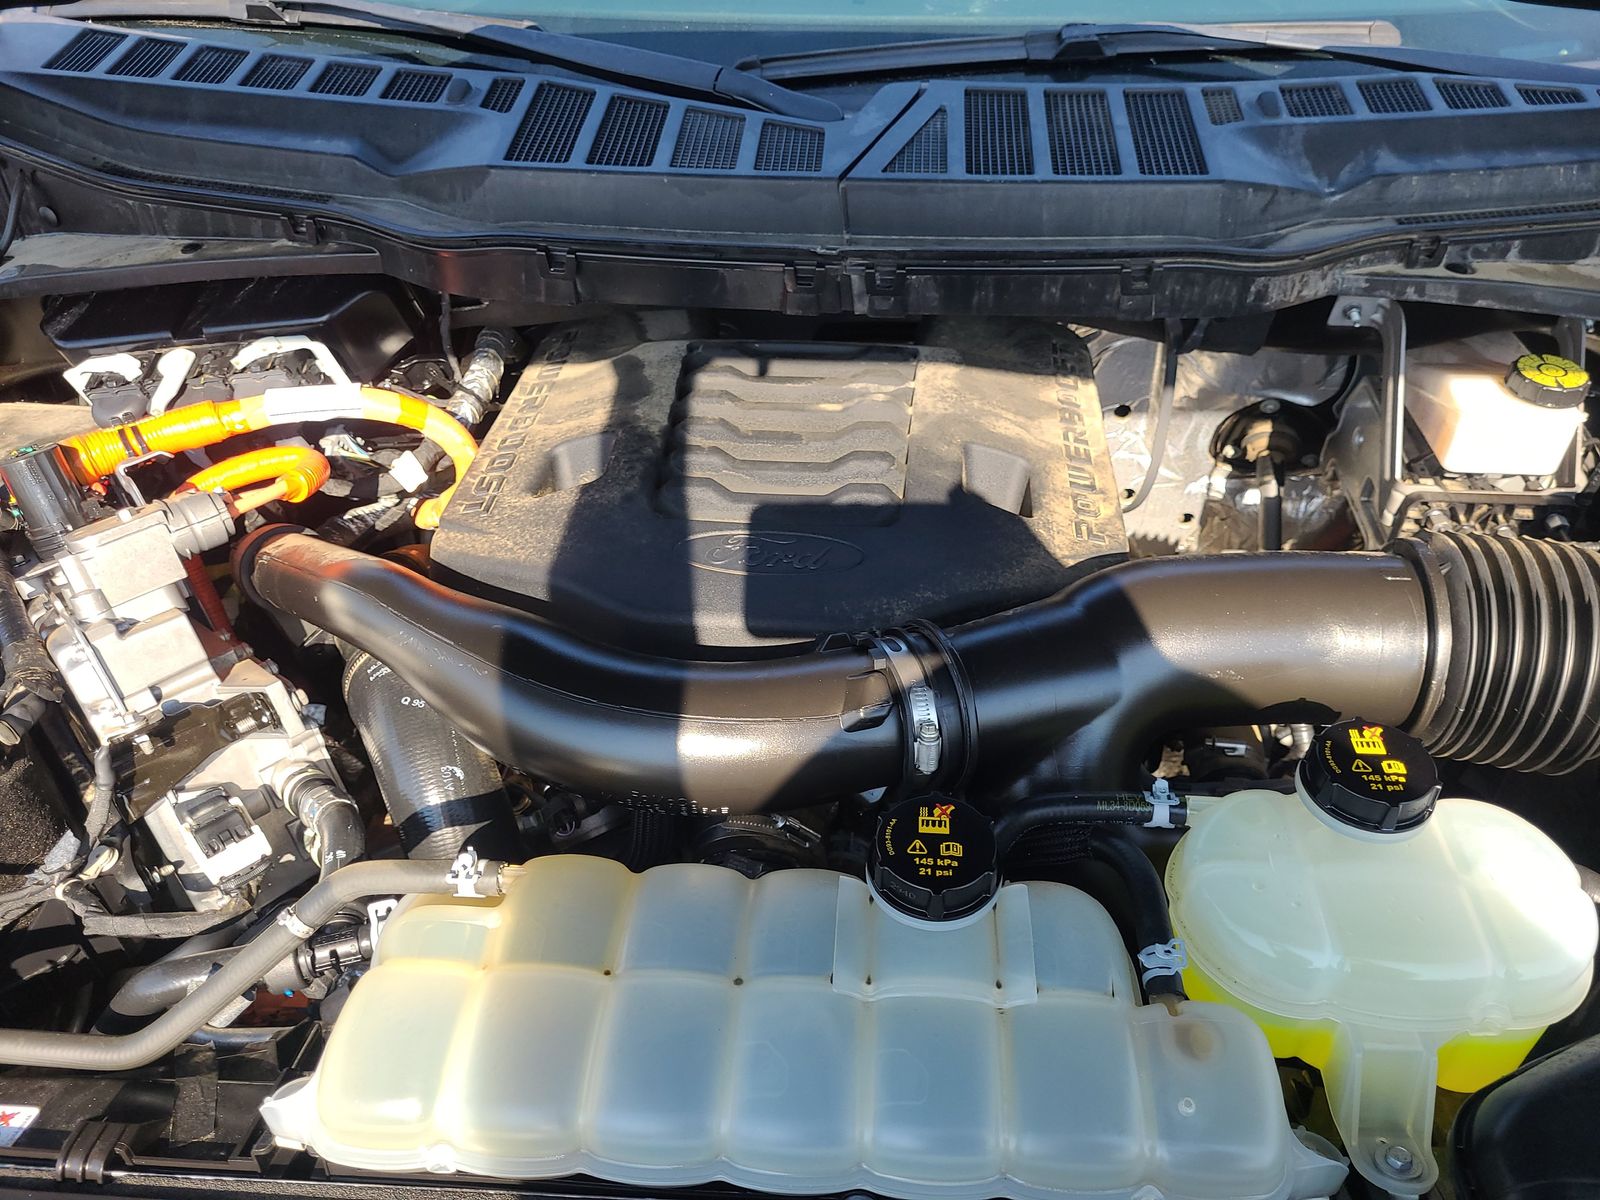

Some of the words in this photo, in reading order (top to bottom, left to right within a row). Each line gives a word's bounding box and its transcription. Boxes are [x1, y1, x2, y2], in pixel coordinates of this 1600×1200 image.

[704, 534, 832, 570] Ford
[1361, 774, 1381, 782] 145
[1384, 774, 1406, 783] kPa
[1370, 783, 1383, 791] 21
[1386, 784, 1404, 792] psi
[914, 857, 934, 866] 145
[936, 858, 959, 867] kPa
[918, 867, 932, 876] 21
[935, 868, 953, 877] psi
